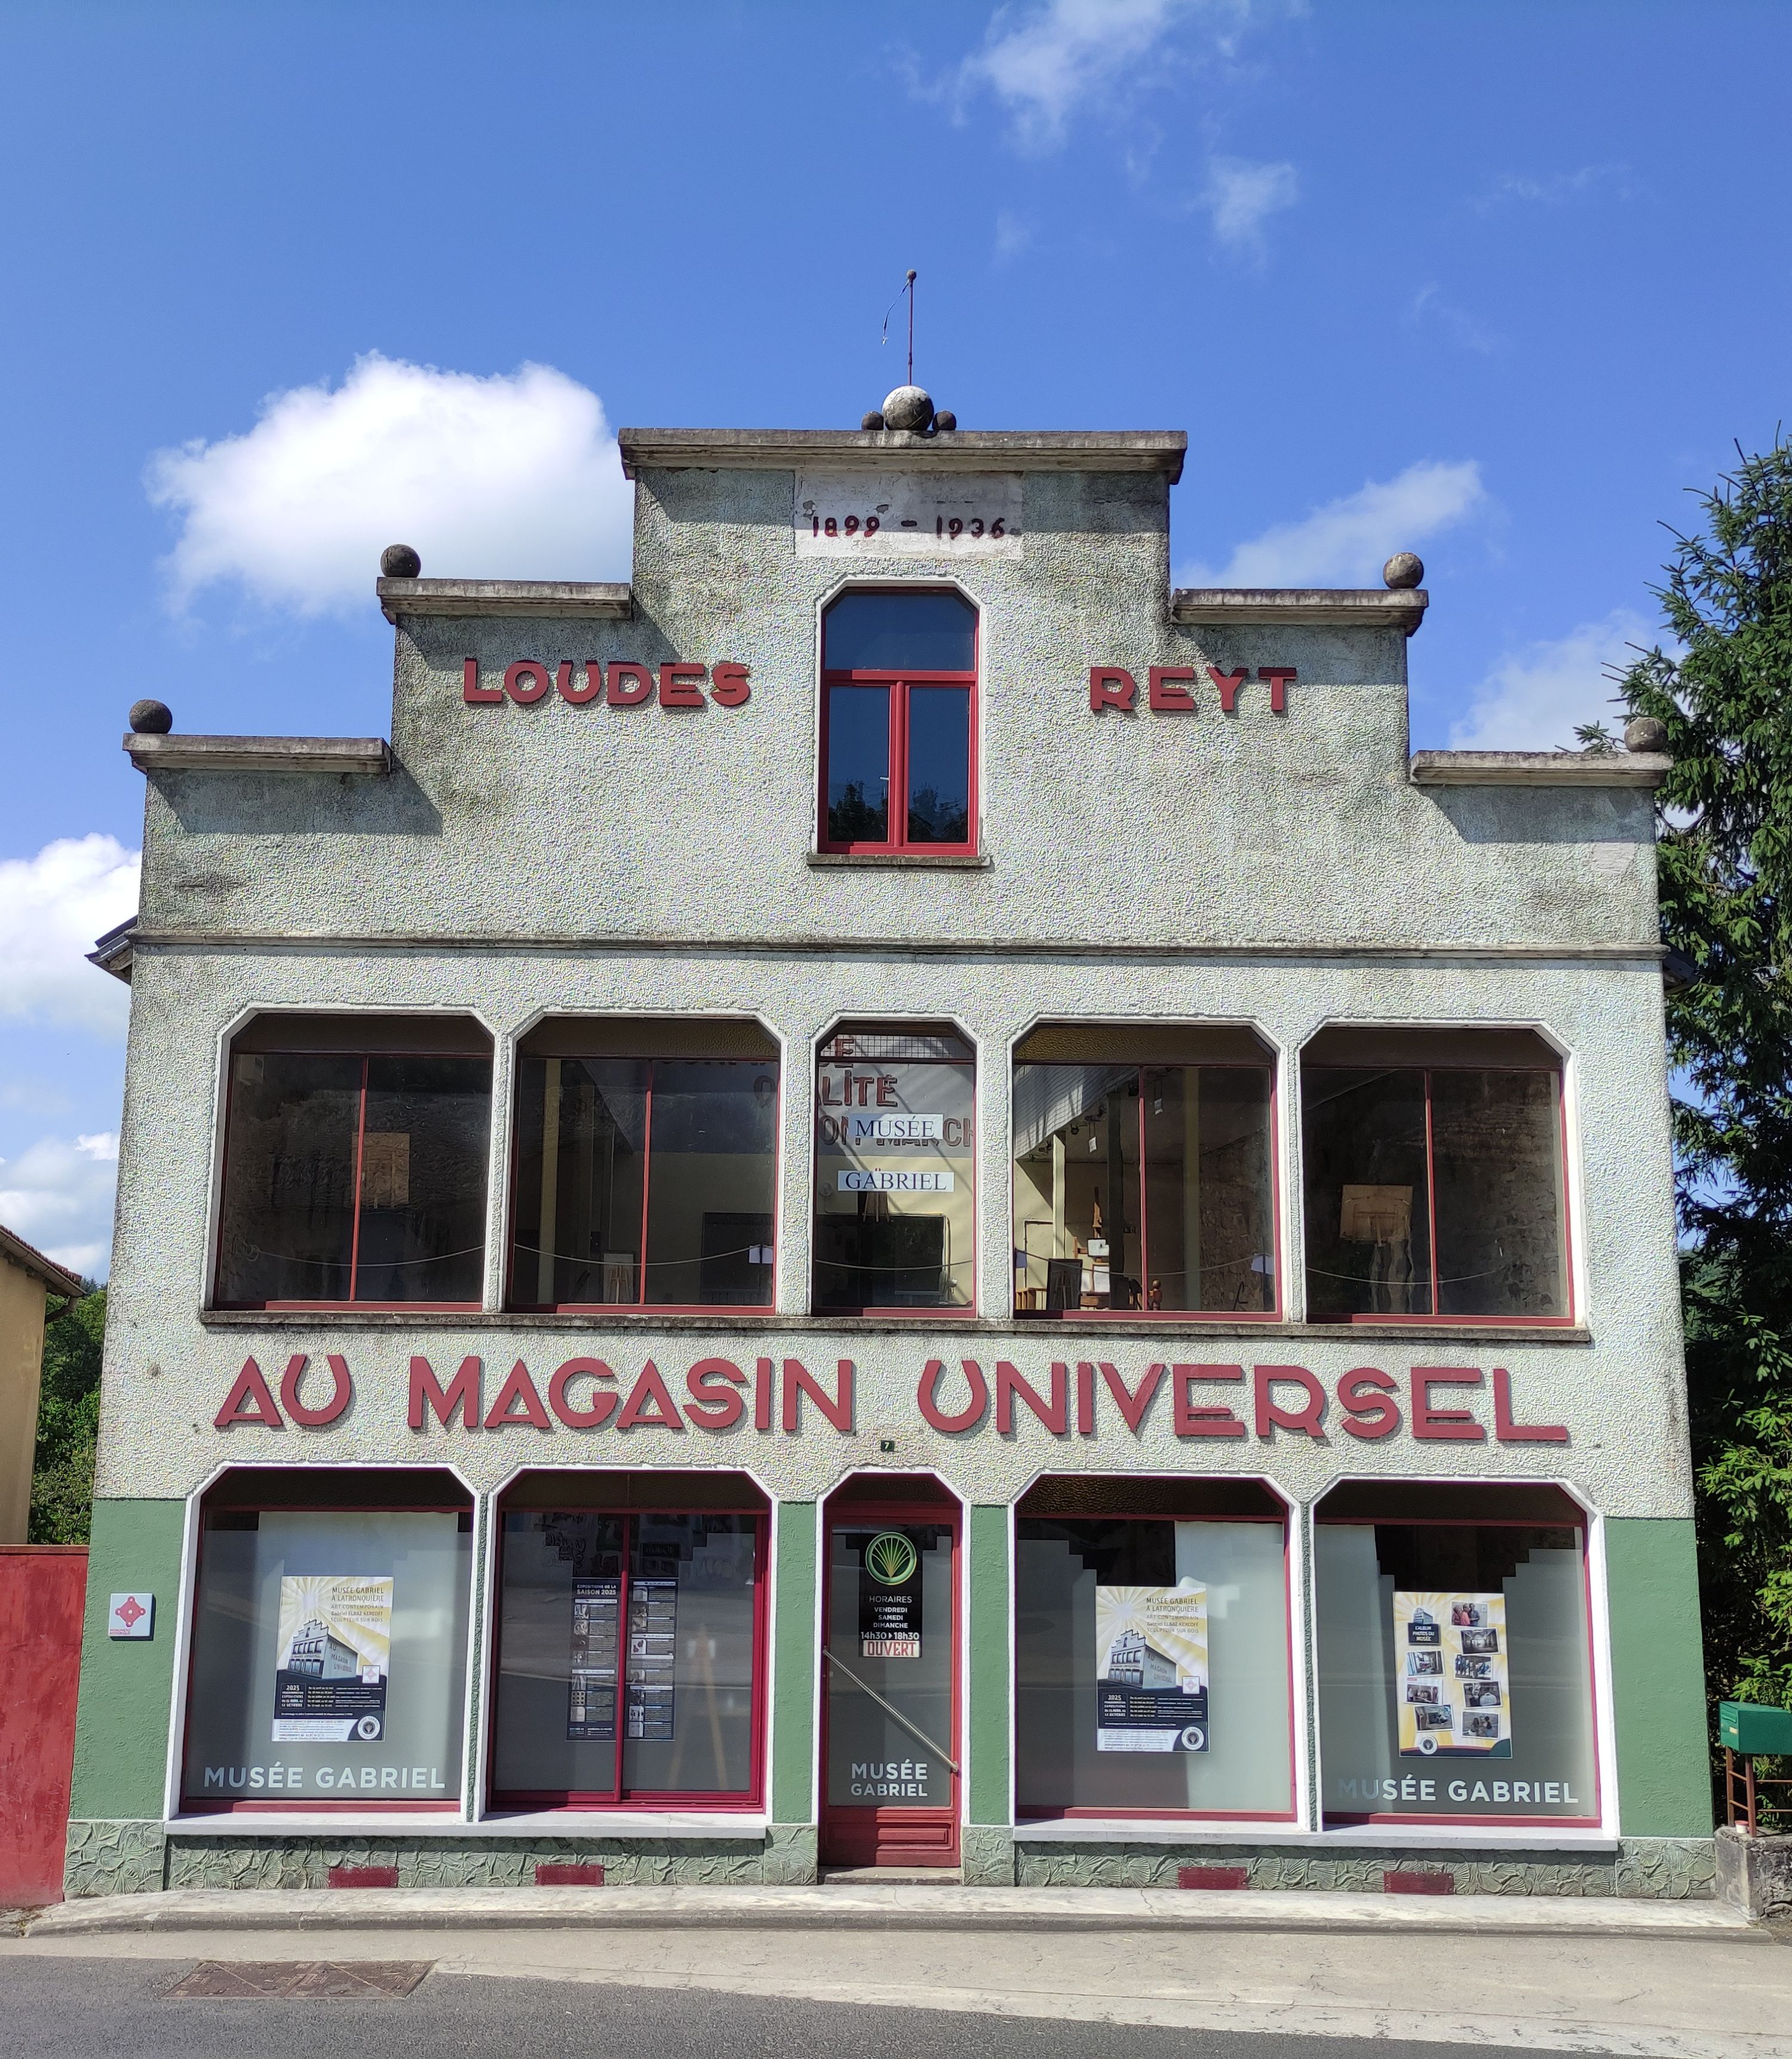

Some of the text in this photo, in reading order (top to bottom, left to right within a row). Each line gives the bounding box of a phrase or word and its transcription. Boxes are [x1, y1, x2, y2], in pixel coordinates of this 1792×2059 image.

[812, 515, 880, 537] 1899
[936, 515, 1005, 540] 1936
[463, 658, 751, 706] LOUDES
[1090, 667, 1297, 711] REYT
[855, 1116, 935, 1137] MUSÉE
[845, 1171, 947, 1190] GABRIEL
[213, 1354, 1568, 1442] AU MAGASIN UNIVERSEL
[1146, 1596, 1168, 1604] MUSÉE
[867, 1641, 916, 1656] OUVERT
[204, 1760, 446, 1788] MUSÉE GABRIEL
[851, 1759, 928, 1779] MUSÉE
[851, 1783, 928, 1797] GABRIEL
[1337, 1773, 1579, 1803] MUSÉE GABRIEL
